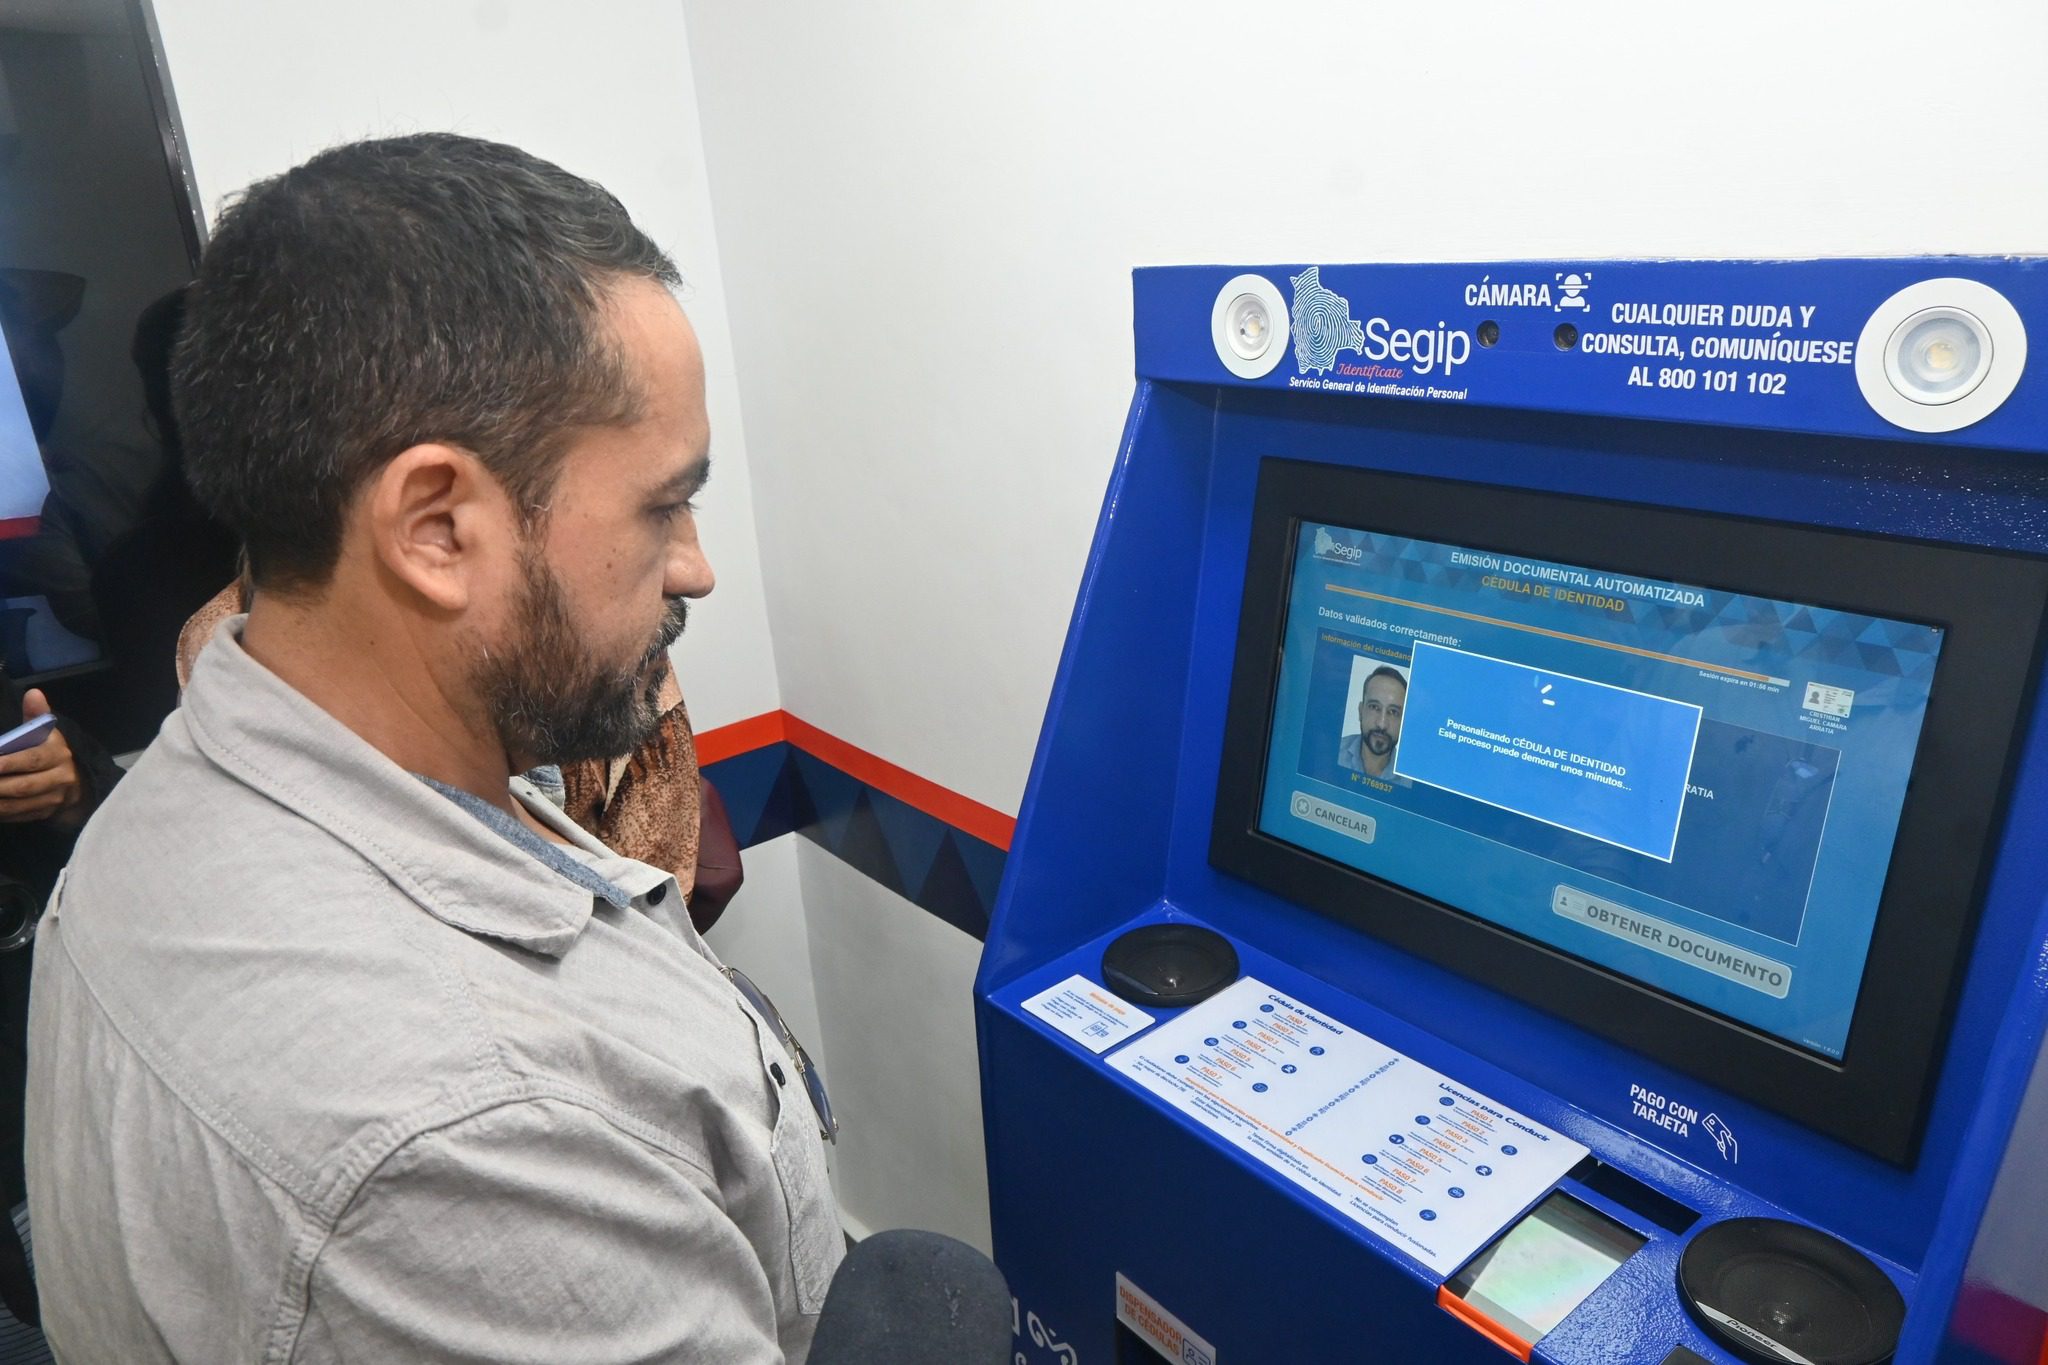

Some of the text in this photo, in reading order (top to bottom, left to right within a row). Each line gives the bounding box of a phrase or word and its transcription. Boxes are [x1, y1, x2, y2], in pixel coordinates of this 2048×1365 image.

[1464, 275, 1551, 306] CÁMARA
[1612, 303, 1816, 328] CUALQUIER DUDA Y
[1364, 318, 1470, 375] Segip
[1582, 332, 1854, 365] CONSULTA, COMUNÍQUESE
[1288, 376, 1468, 400] Servicio General de Identificación Personal
[1628, 366, 1786, 395] AL 800 101 102
[1334, 542, 1362, 560] Segip
[1450, 551, 1705, 608] EMISIÓN DOCUMENTAL AUTOMATIZADA
[1482, 575, 1624, 612] CÉDULA DE IDENTIDAD
[1318, 606, 1462, 648] Datos validados correctamente:
[1363, 643, 1374, 652] del
[1438, 728, 1632, 791] Este proceso puede demorar unos minutos...
[1447, 719, 1626, 776] Personalizando CÉDULA DE IDENTIDAD
[1314, 807, 1368, 834] CANCELAR
[1586, 904, 1782, 988] OBTENER DOCUMENTO
[1266, 993, 1296, 1010] Cédula
[1293, 1007, 1307, 1015] de
[1303, 1013, 1344, 1034] identidad
[1437, 1082, 1482, 1106] Licencias
[1479, 1105, 1504, 1119] para
[1503, 1116, 1551, 1142] Conducir
[1470, 1109, 1489, 1120] PASO
[1630, 1084, 1698, 1124] PAGO CON
[1460, 1120, 1480, 1132] PASO
[1632, 1100, 1688, 1138] TARJETA
[1432, 1138, 1451, 1149] PASO
[1444, 1128, 1463, 1140] PASO
[1405, 1157, 1425, 1170] PASO
[1418, 1148, 1438, 1160] PASO
[1377, 1178, 1398, 1191] PASO
[1391, 1168, 1411, 1180] PASO
[1726, 1320, 1778, 1348] Pioneer
